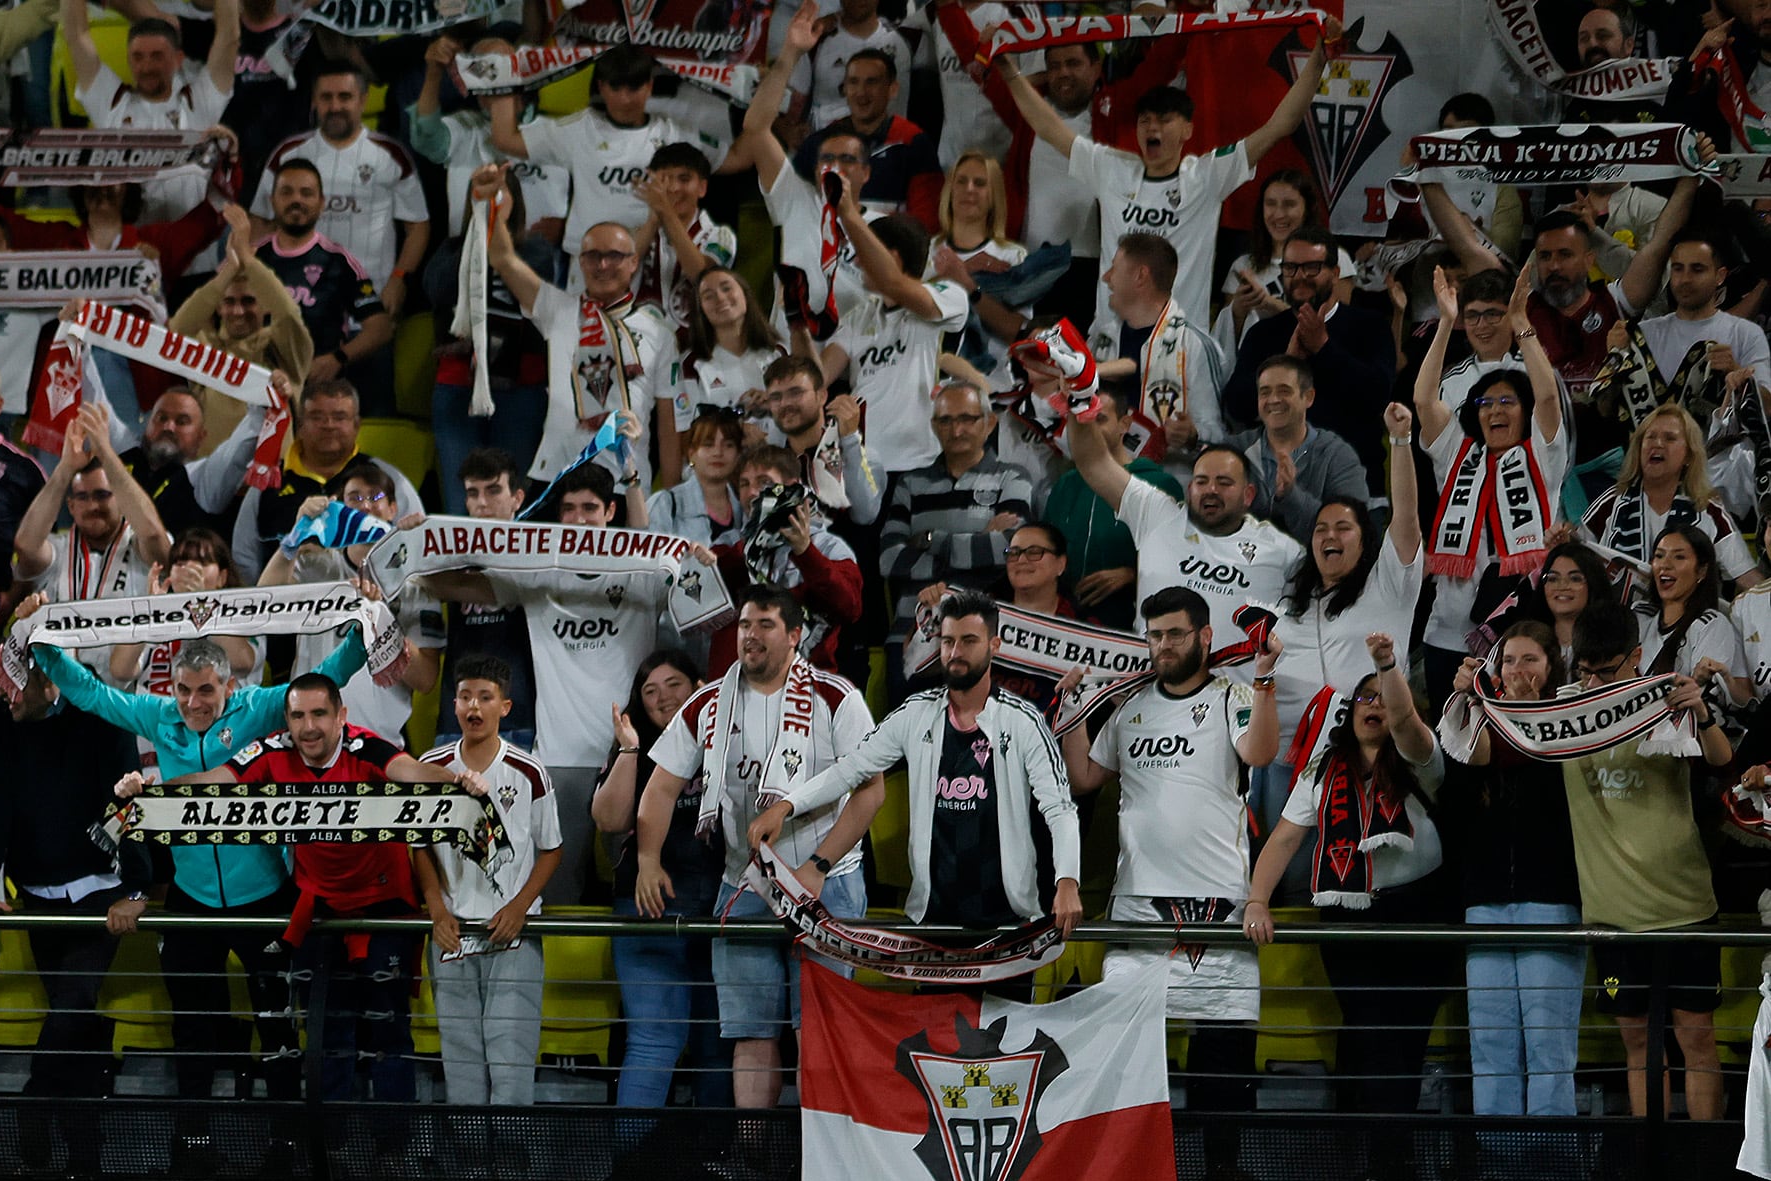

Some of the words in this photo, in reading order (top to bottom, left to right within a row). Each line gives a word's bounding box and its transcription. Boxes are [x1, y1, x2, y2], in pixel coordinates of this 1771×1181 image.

[1418, 138, 1502, 164] PEÑA
[1515, 137, 1659, 164] K'TOMAS
[423, 523, 550, 559] ALBACETE
[1179, 555, 1252, 589] iner
[45, 606, 183, 633] albacete
[1000, 624, 1061, 659] CETE
[1128, 734, 1194, 759] iner
[286, 785, 299, 796] EL
[311, 784, 347, 796] ALBA
[181, 800, 361, 828] ALBACETE
[393, 799, 452, 826] B.P.
[285, 832, 299, 844] EL
[310, 831, 343, 842] ALBA
